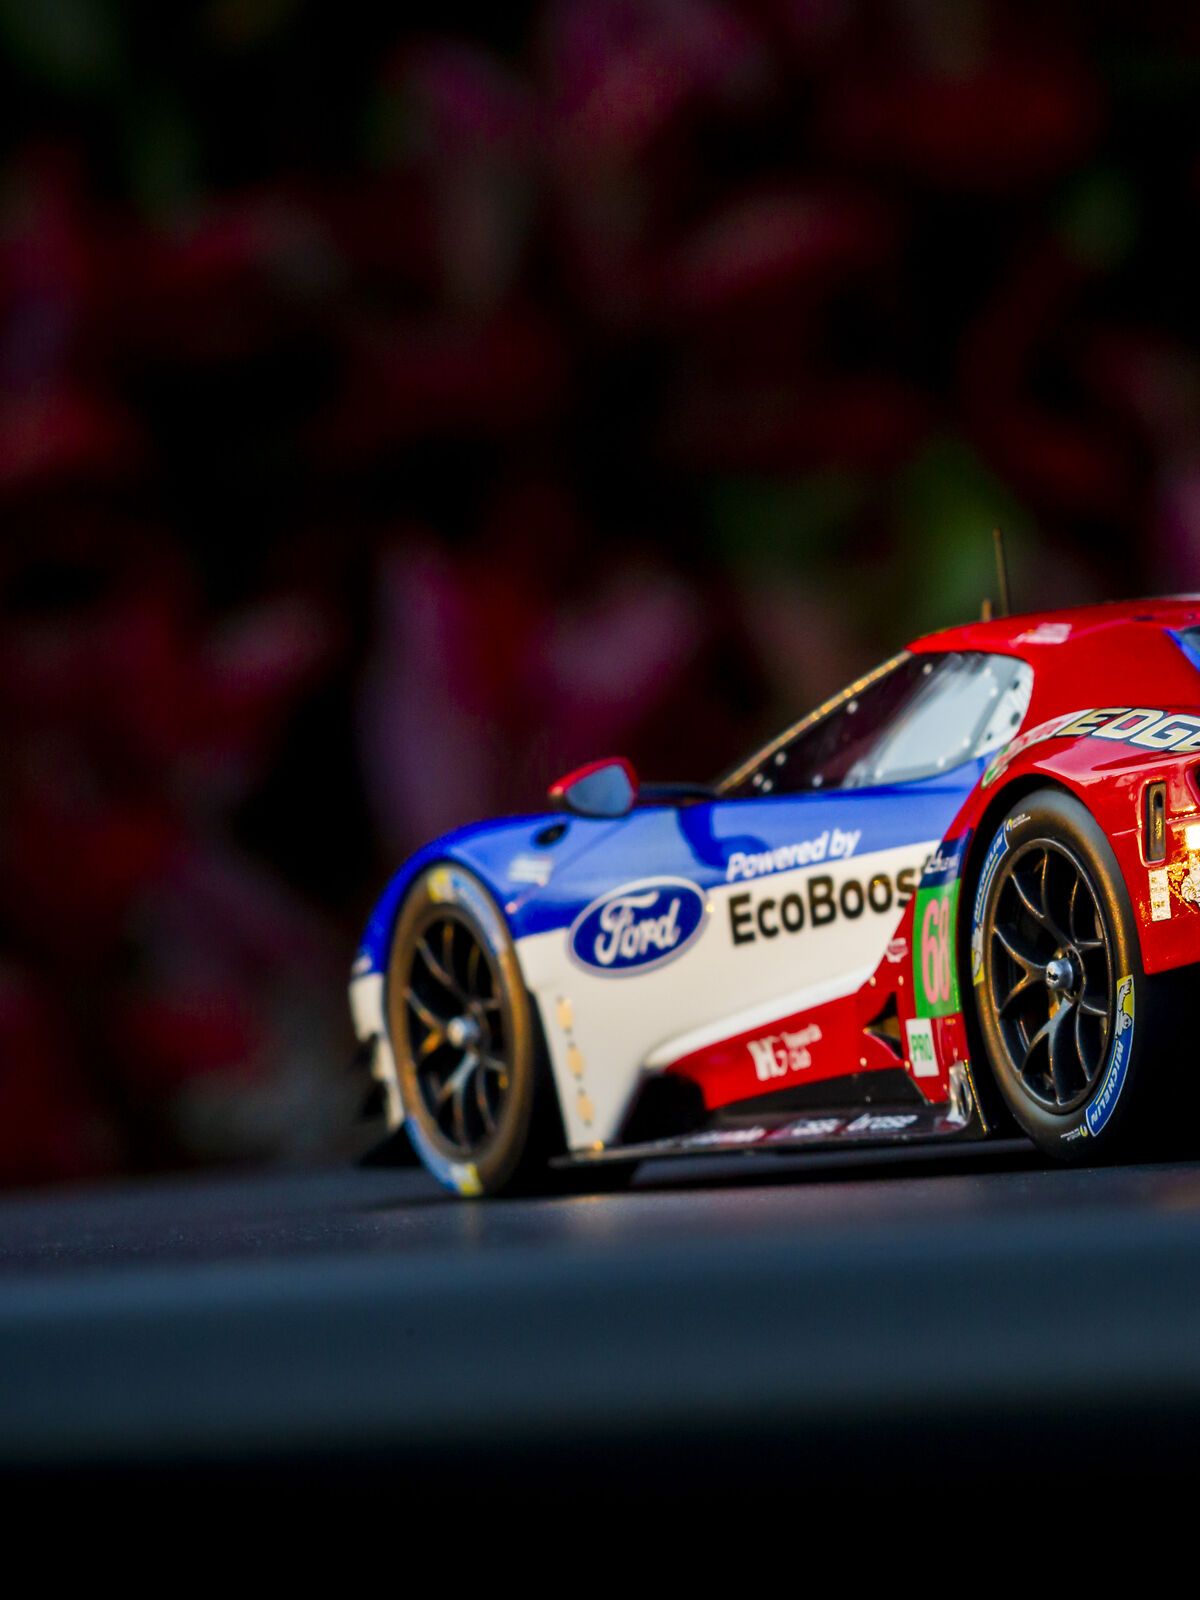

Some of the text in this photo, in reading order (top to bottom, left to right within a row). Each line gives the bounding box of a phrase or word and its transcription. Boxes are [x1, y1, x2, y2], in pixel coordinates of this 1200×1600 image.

[726, 828, 861, 882] Powered by
[595, 890, 681, 965] Ford
[921, 898, 950, 1005] 68
[911, 1033, 933, 1062] PRO
[1091, 1040, 1125, 1126] MICHELIN
